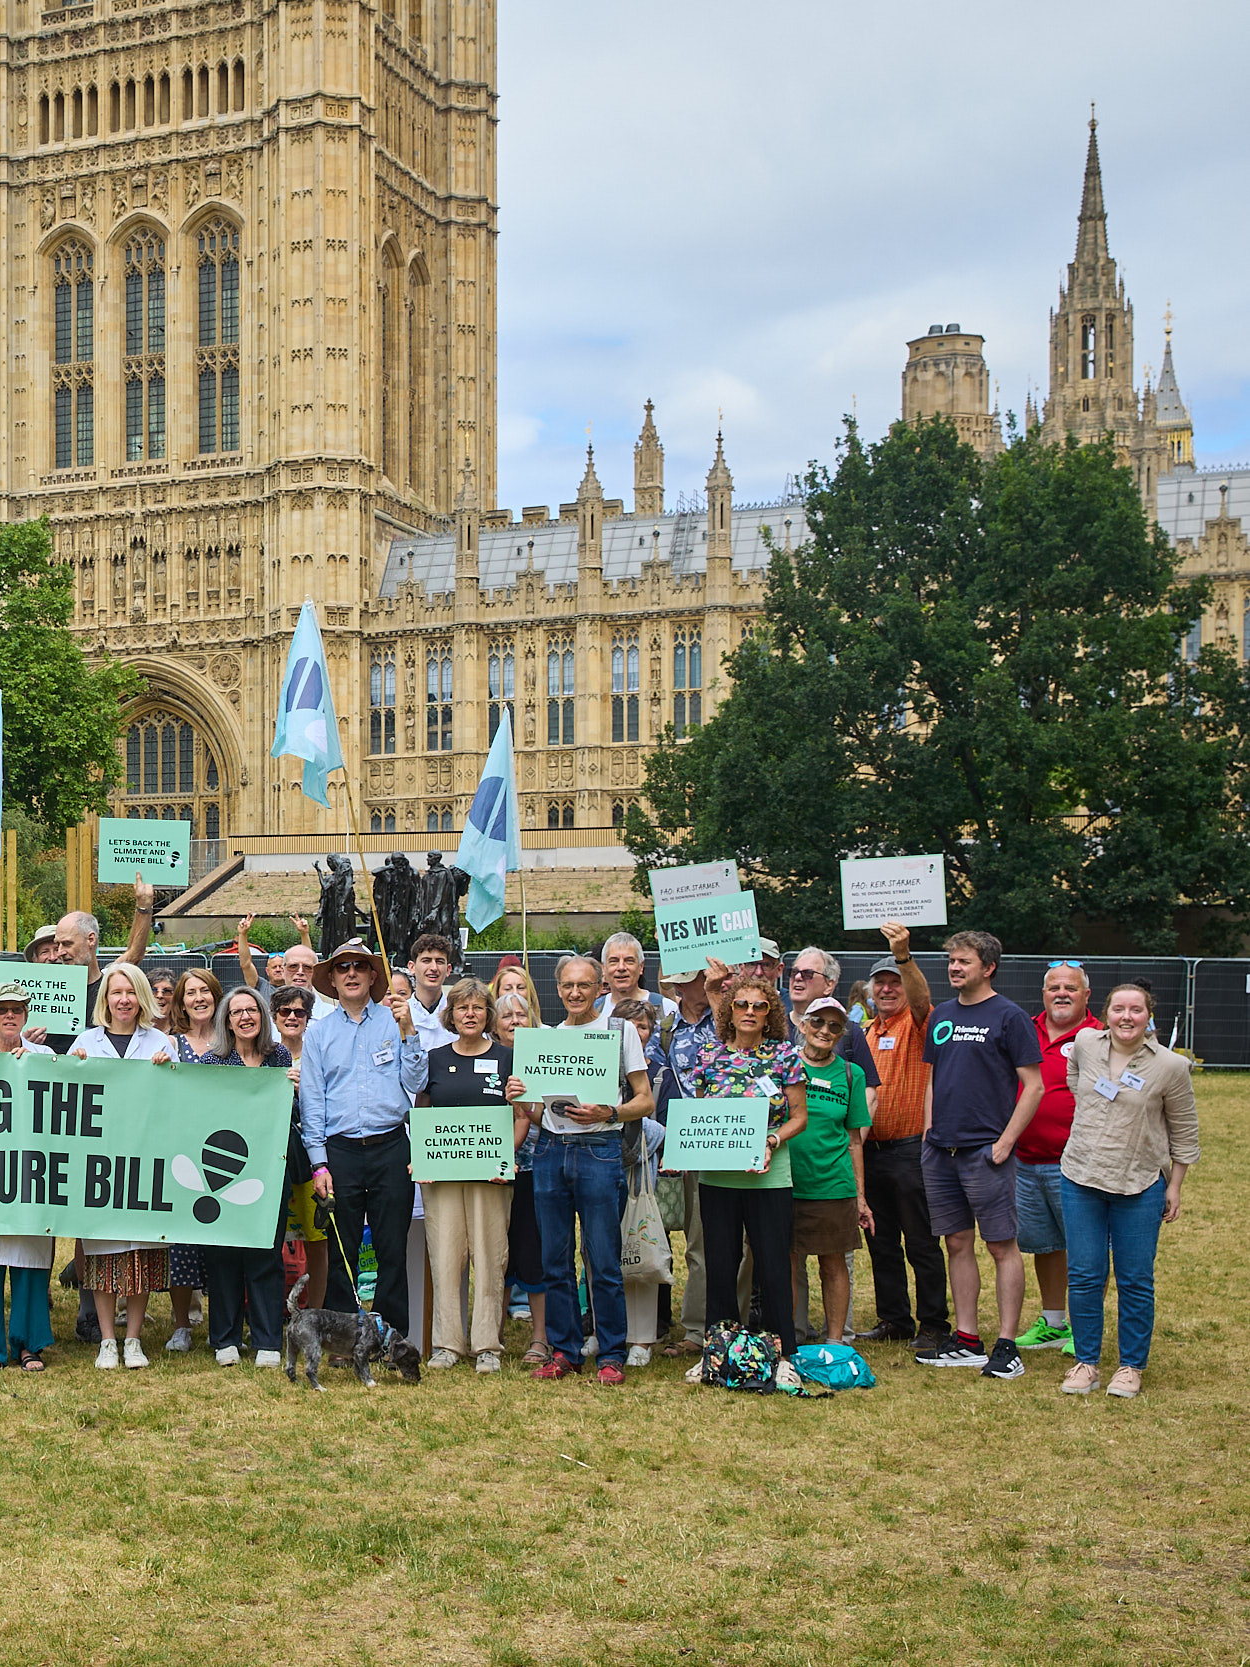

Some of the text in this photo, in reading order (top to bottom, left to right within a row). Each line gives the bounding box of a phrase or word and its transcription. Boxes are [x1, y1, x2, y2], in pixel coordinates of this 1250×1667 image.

[155, 840, 171, 848] THE
[692, 882, 720, 892] STARMER
[851, 878, 921, 890] FAO: KEIR STARMER
[660, 908, 753, 942] YES WE CAN
[691, 941, 714, 949] CLIMATE
[720, 936, 743, 944] NATURE
[45, 980, 67, 990] THE
[53, 993, 76, 1002] AND
[29, 1004, 74, 1014] URE BILL
[963, 1033, 986, 1043] Earth
[538, 1055, 594, 1065] RESTORE
[524, 1066, 607, 1077] NATURE NOW
[27, 1080, 105, 1138] THE
[691, 1115, 746, 1124] BACK THE
[435, 1124, 492, 1134] BACK THE
[679, 1128, 755, 1136] CLIMATE AND
[424, 1137, 503, 1146] CLIMATE AND
[680, 1141, 752, 1149] NATURE BILL
[427, 1150, 501, 1159] NATURE BILL
[84, 1154, 173, 1212] BILL
